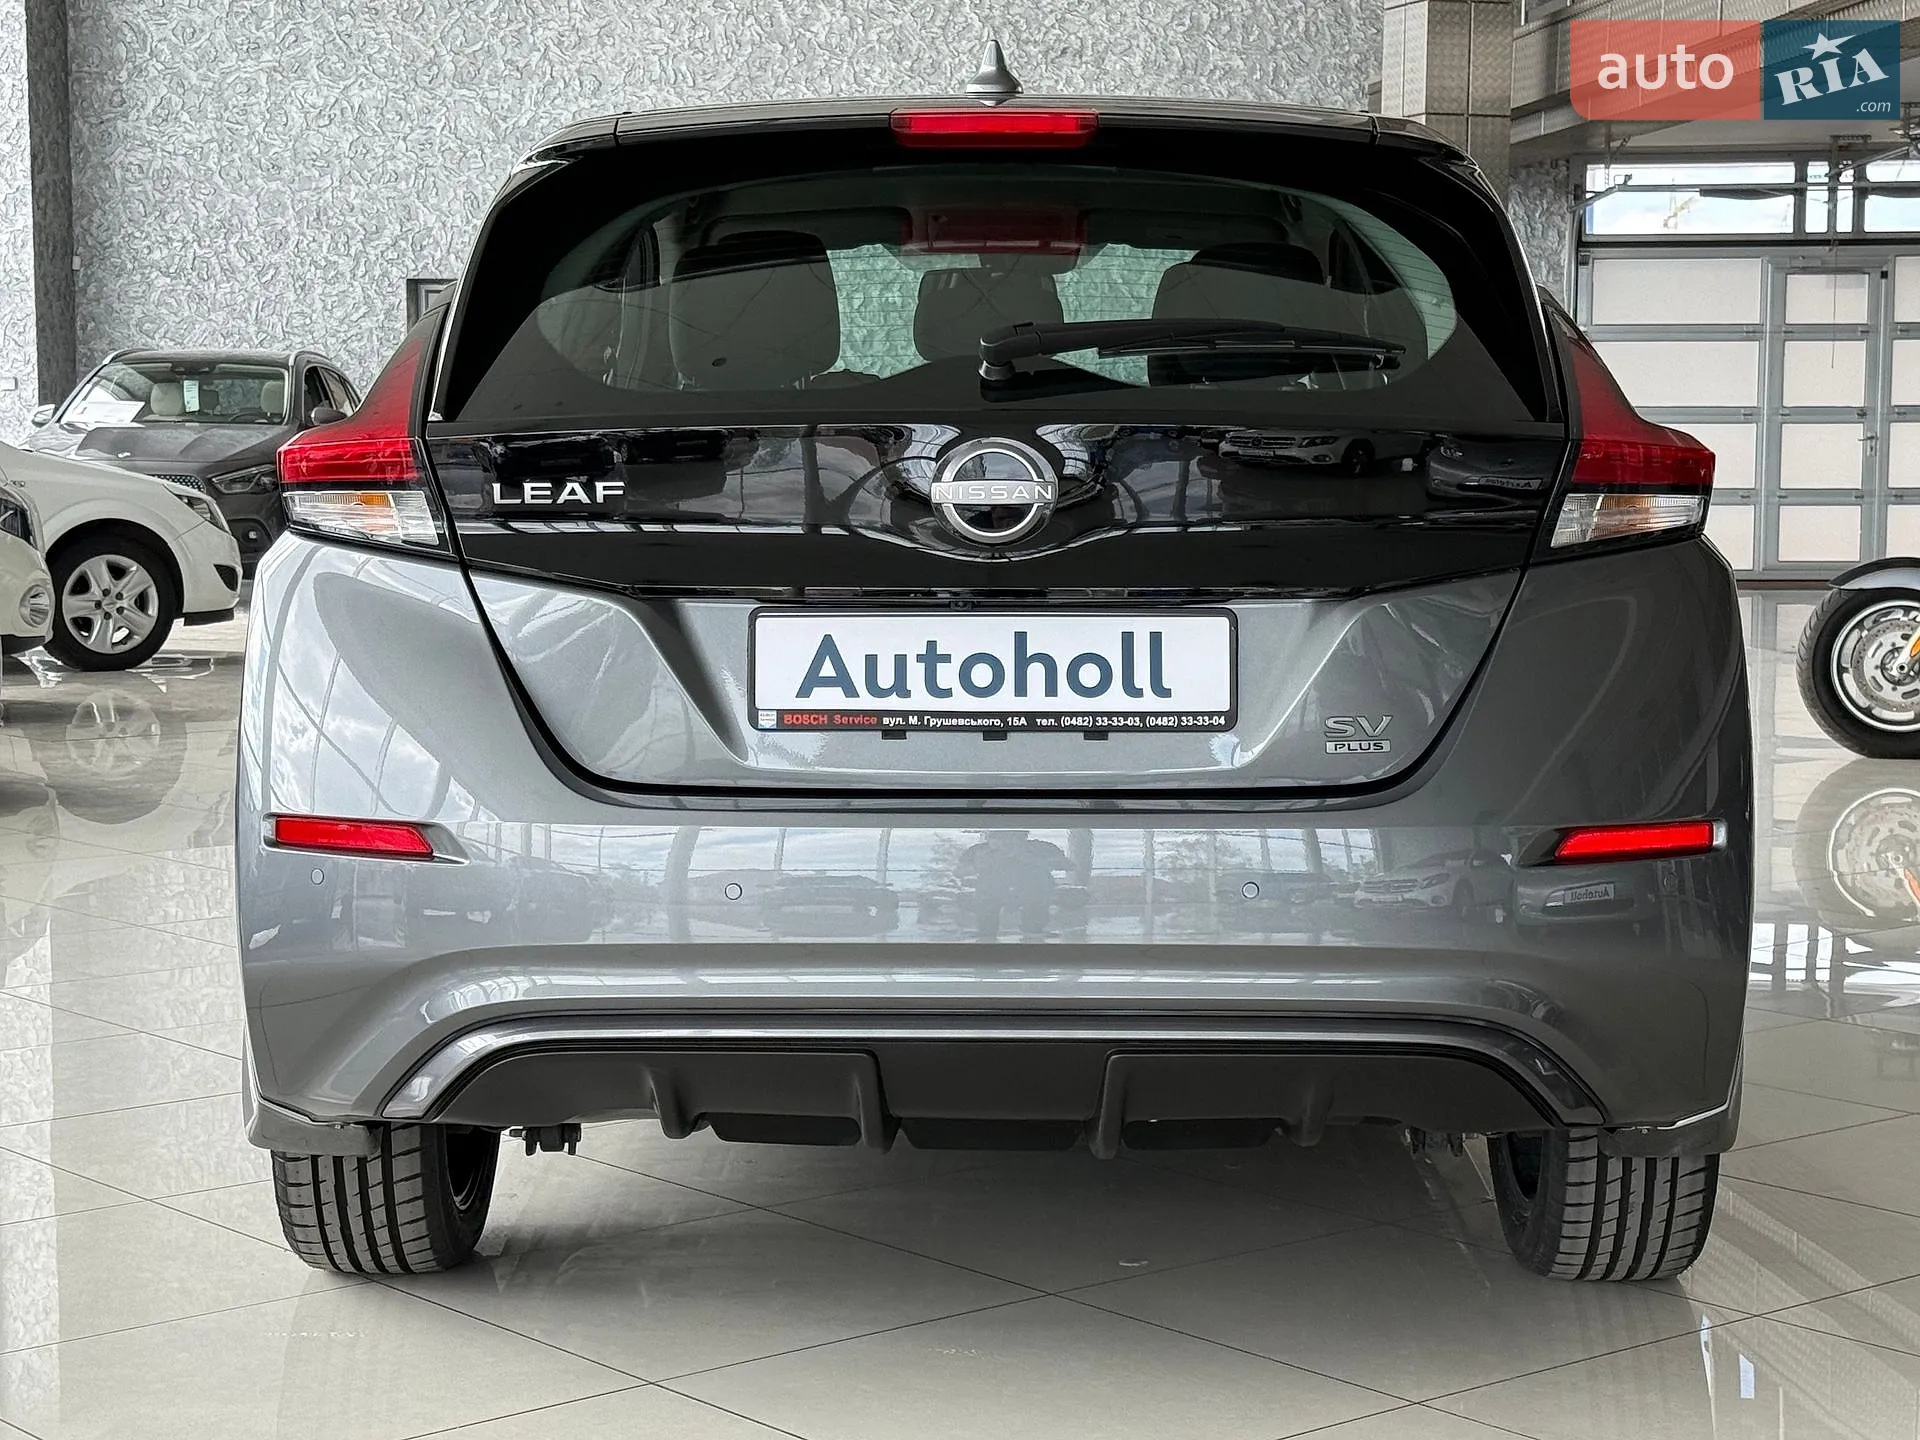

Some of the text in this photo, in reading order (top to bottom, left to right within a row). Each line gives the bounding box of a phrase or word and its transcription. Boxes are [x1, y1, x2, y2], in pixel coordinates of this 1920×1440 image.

[491, 481, 626, 504] LEAF
[935, 484, 1052, 500] NISSAN
[795, 631, 1172, 699] Autoholl
[783, 714, 828, 725] BOSCH
[832, 714, 878, 725] Service
[882, 717, 906, 727] вул.
[908, 715, 921, 725] М.
[924, 716, 1004, 727] Грушевського,
[1006, 716, 1028, 726] 15А
[1036, 718, 1058, 726] тел.
[1060, 716, 1093, 727] (0482)
[1095, 716, 1143, 727] 33-33-03,
[1146, 716, 1178, 727] (0482)
[1180, 716, 1226, 726] 33-33-04
[1324, 715, 1393, 738] SV
[1334, 742, 1384, 752] PLUS
